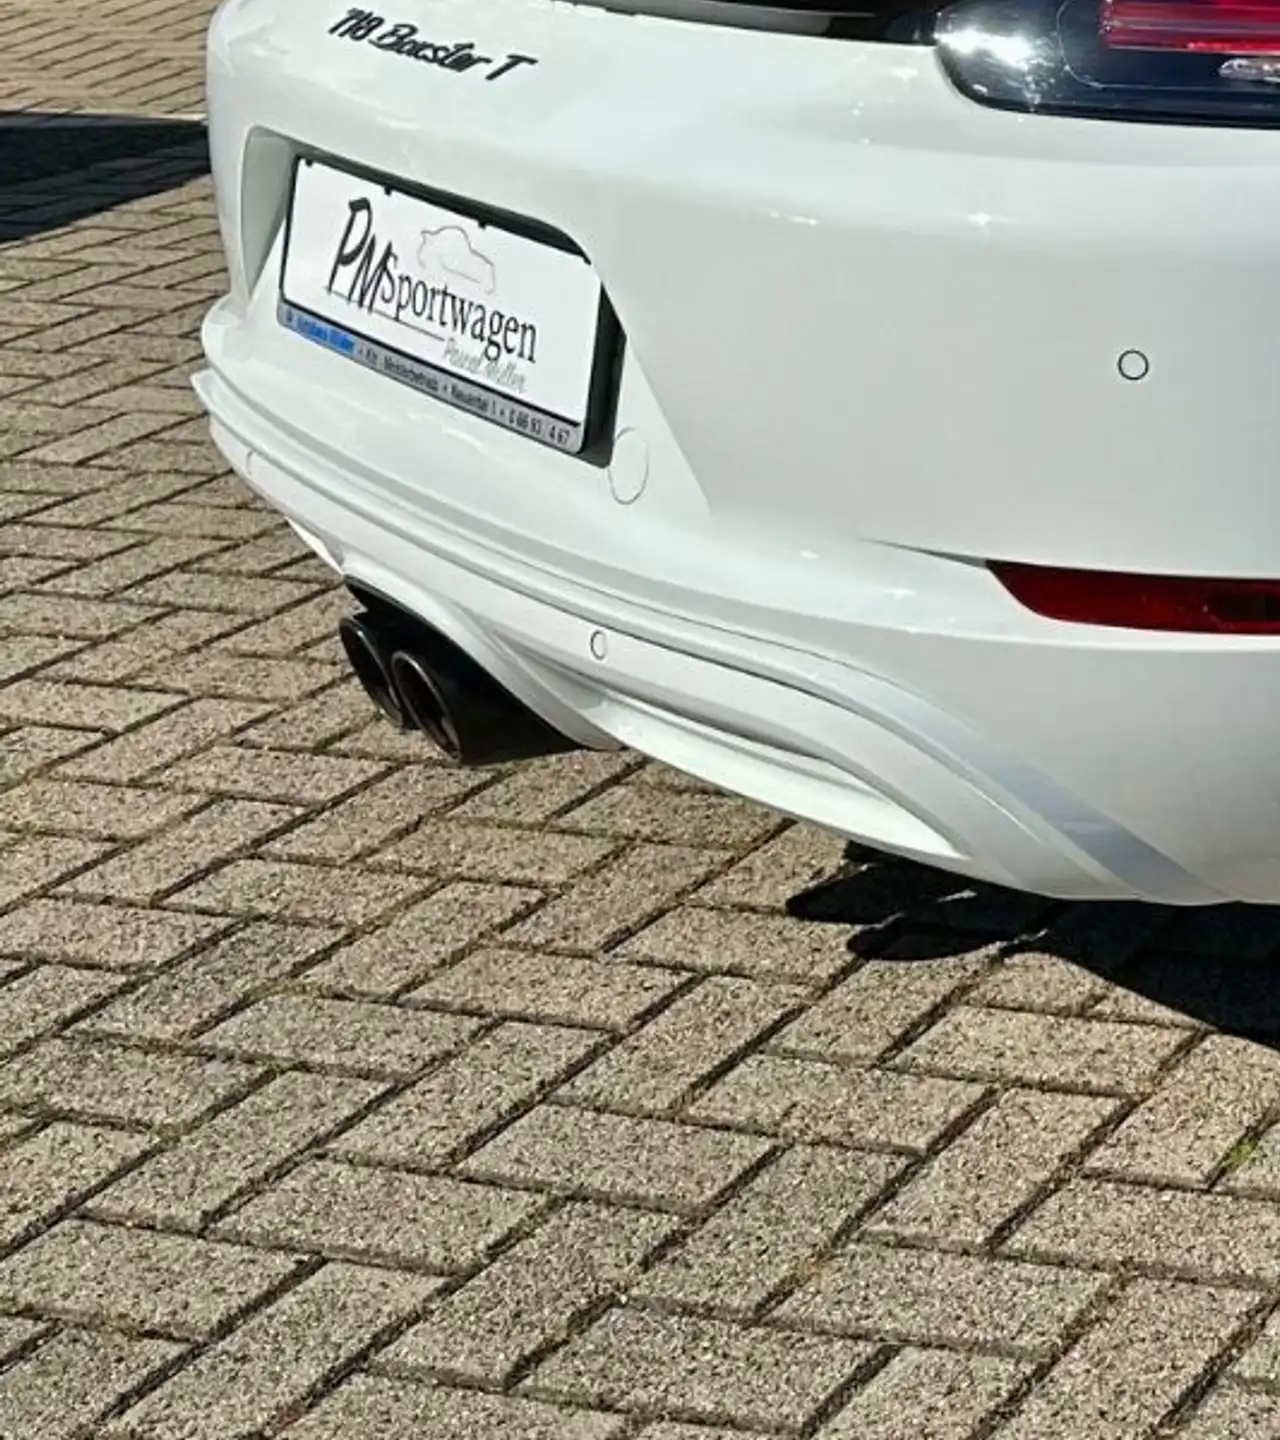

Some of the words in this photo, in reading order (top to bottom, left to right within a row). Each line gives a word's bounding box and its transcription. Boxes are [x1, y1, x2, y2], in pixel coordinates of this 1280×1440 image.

[328, 8, 384, 41] 718
[368, 24, 492, 72] Boxster
[485, 54, 538, 81] T
